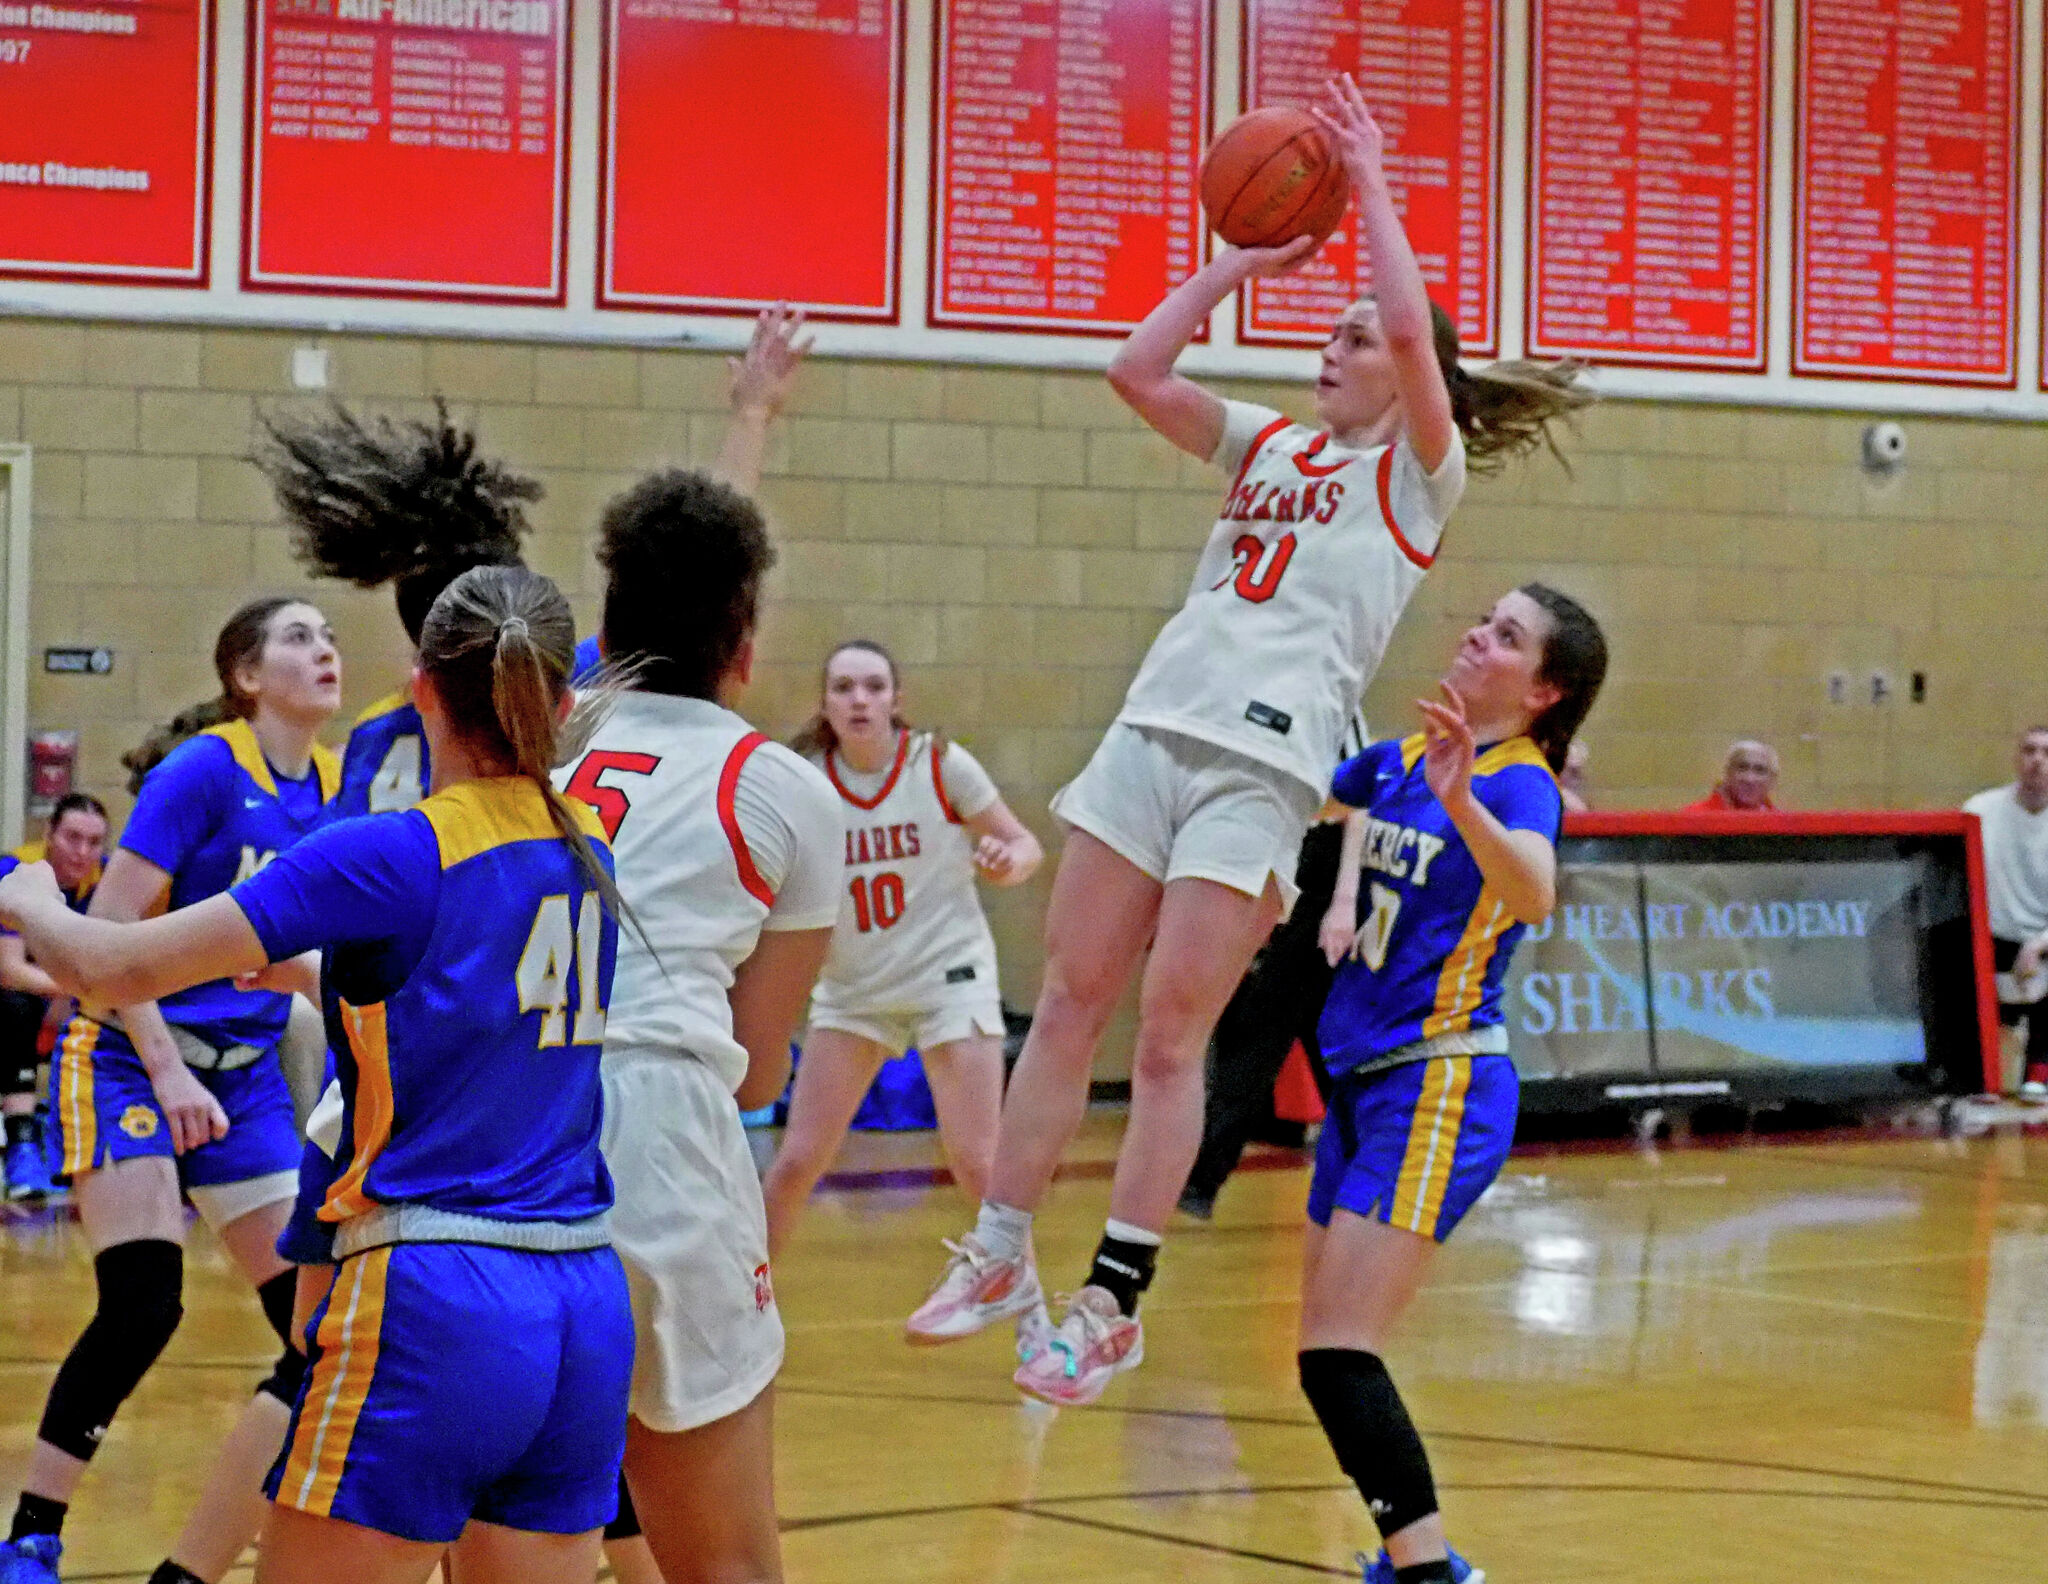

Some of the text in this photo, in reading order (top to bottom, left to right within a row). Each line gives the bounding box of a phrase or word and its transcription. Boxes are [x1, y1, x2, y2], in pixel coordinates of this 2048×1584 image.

[30, 4, 138, 35] Champions
[43, 161, 149, 191] Champions
[1361, 817, 1446, 886] ERCY
[850, 872, 906, 933] 10
[1564, 904, 1688, 941] HEART
[1700, 901, 1871, 938] ACADEMY
[515, 891, 608, 1049] 41
[1522, 968, 1776, 1034] SHARKS
